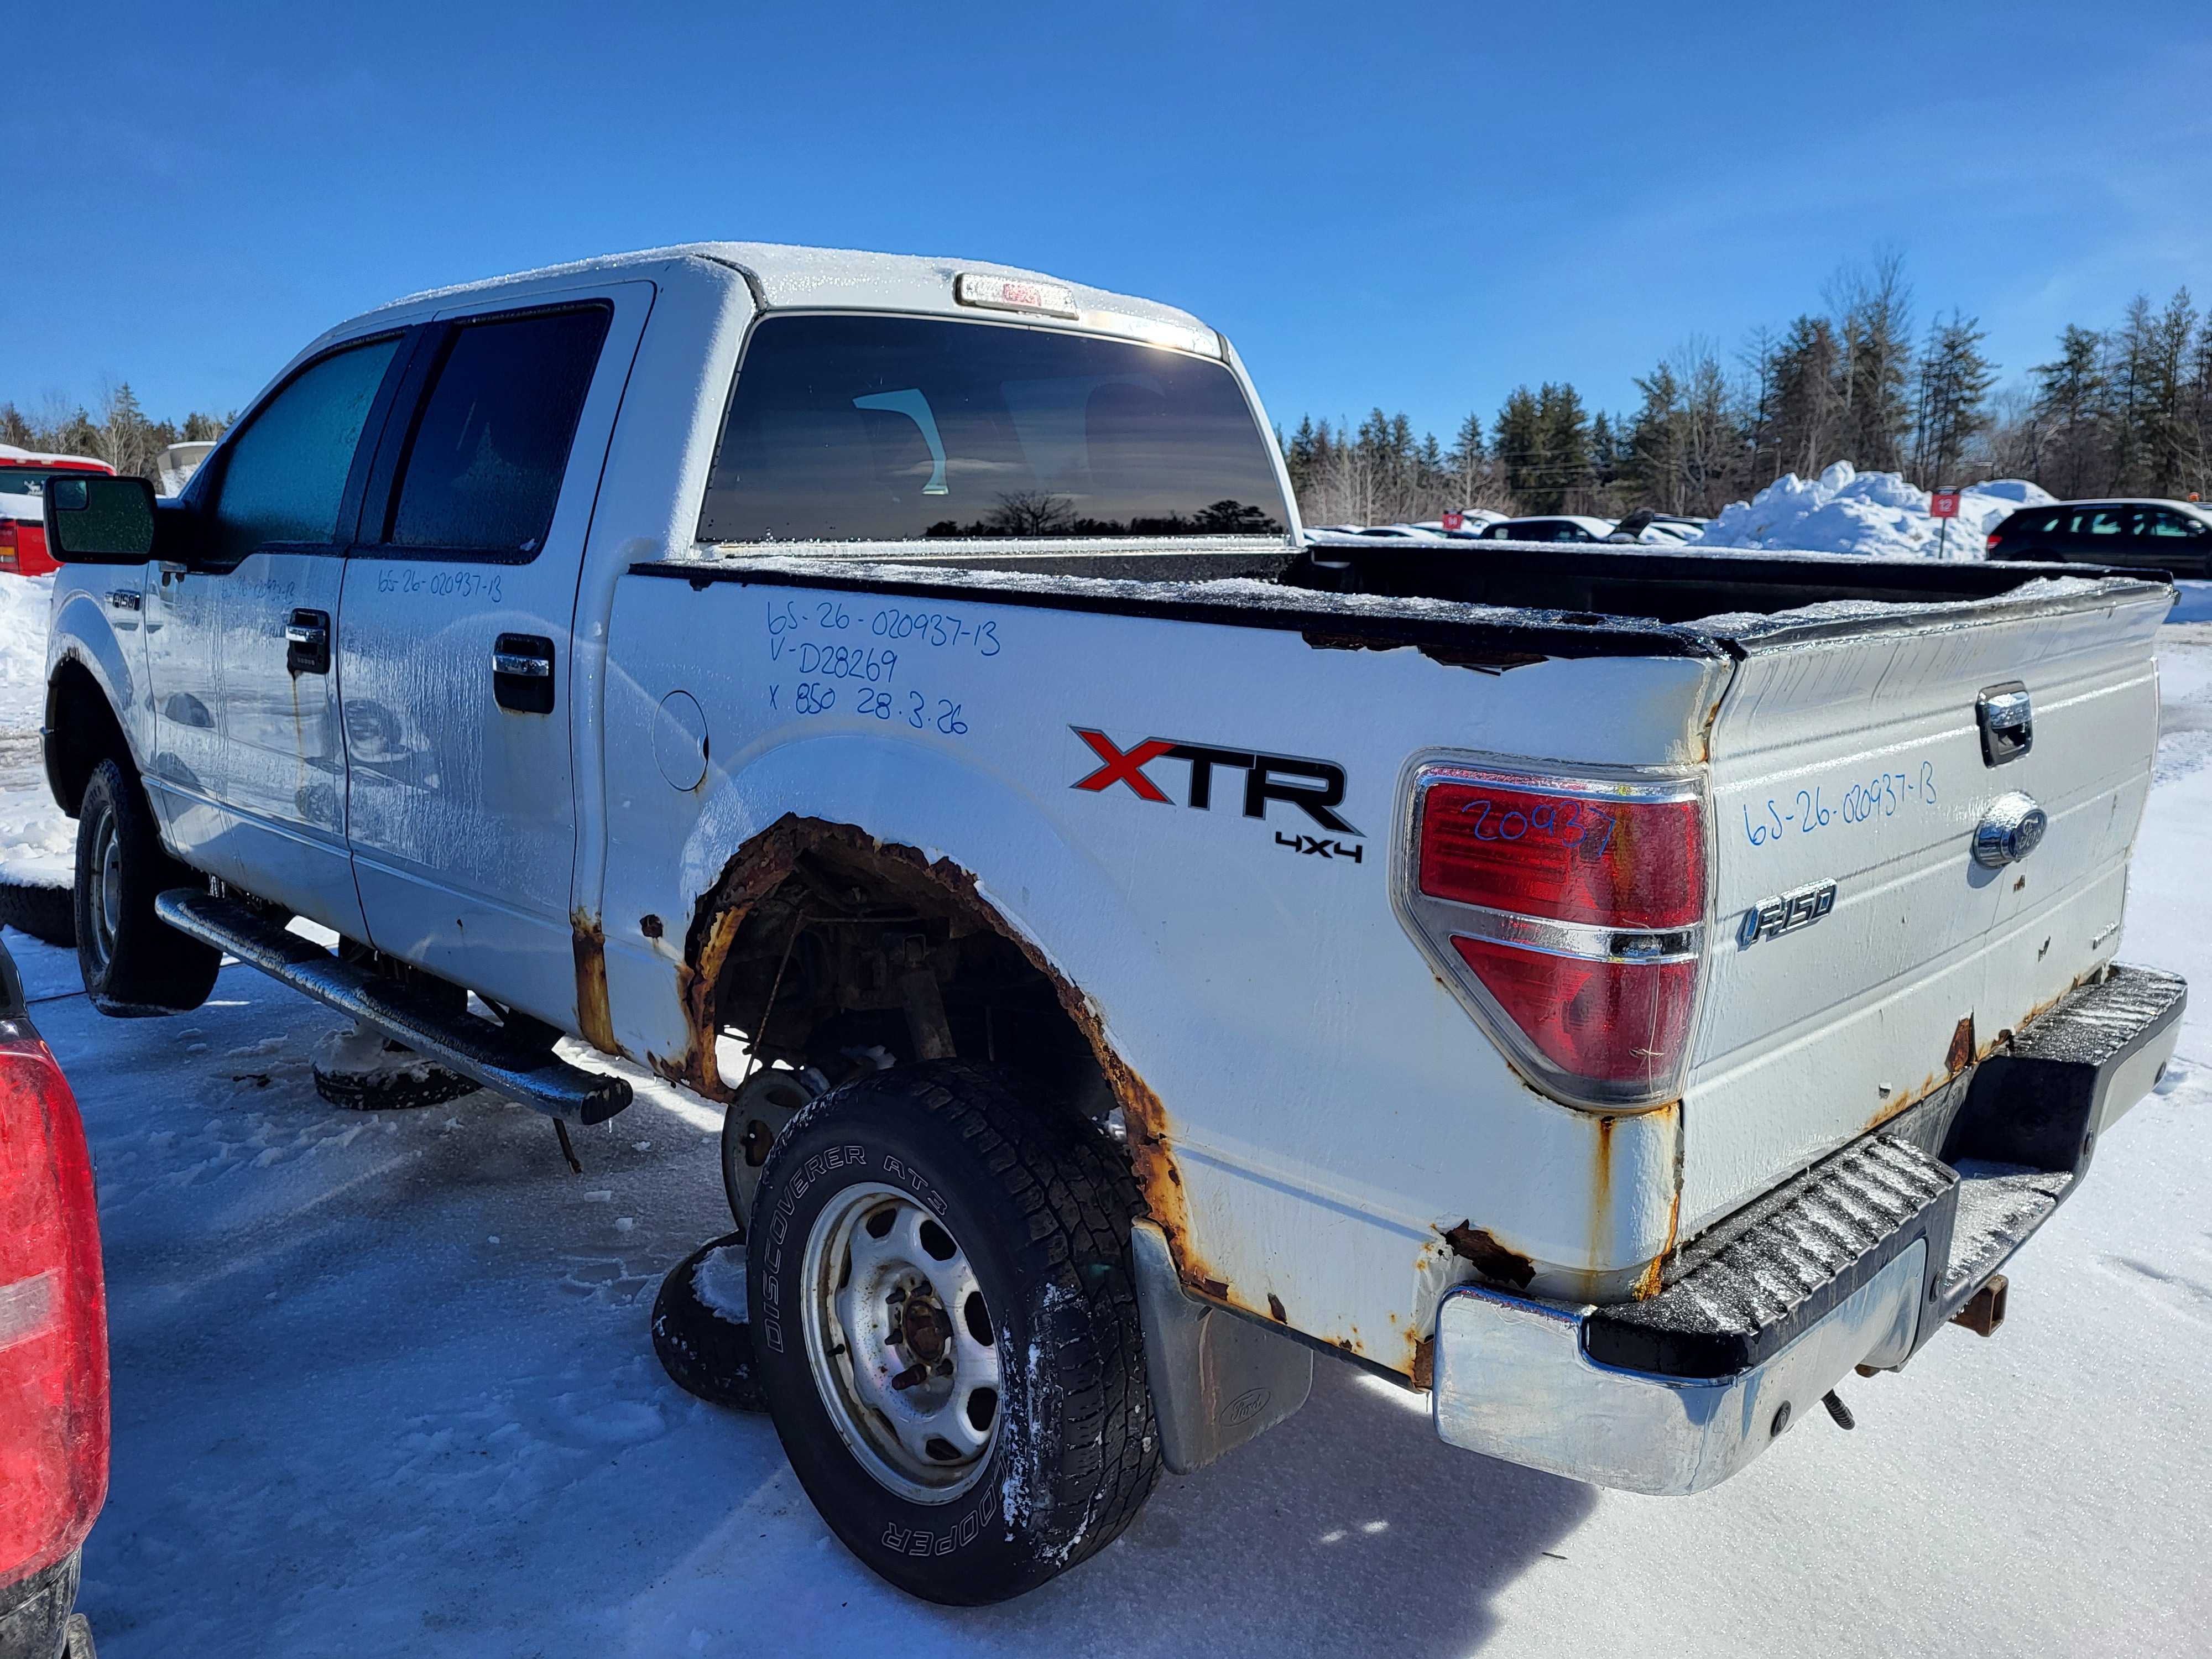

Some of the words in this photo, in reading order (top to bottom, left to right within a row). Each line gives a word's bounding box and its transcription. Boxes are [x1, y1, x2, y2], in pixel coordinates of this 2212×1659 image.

[1938, 498, 1953, 512] 12
[1068, 725, 1367, 838] XTR
[1461, 800, 1616, 857] 20937
[763, 1145, 867, 1354] DISCOVERER
[1230, 1394, 1262, 1423] Ford
